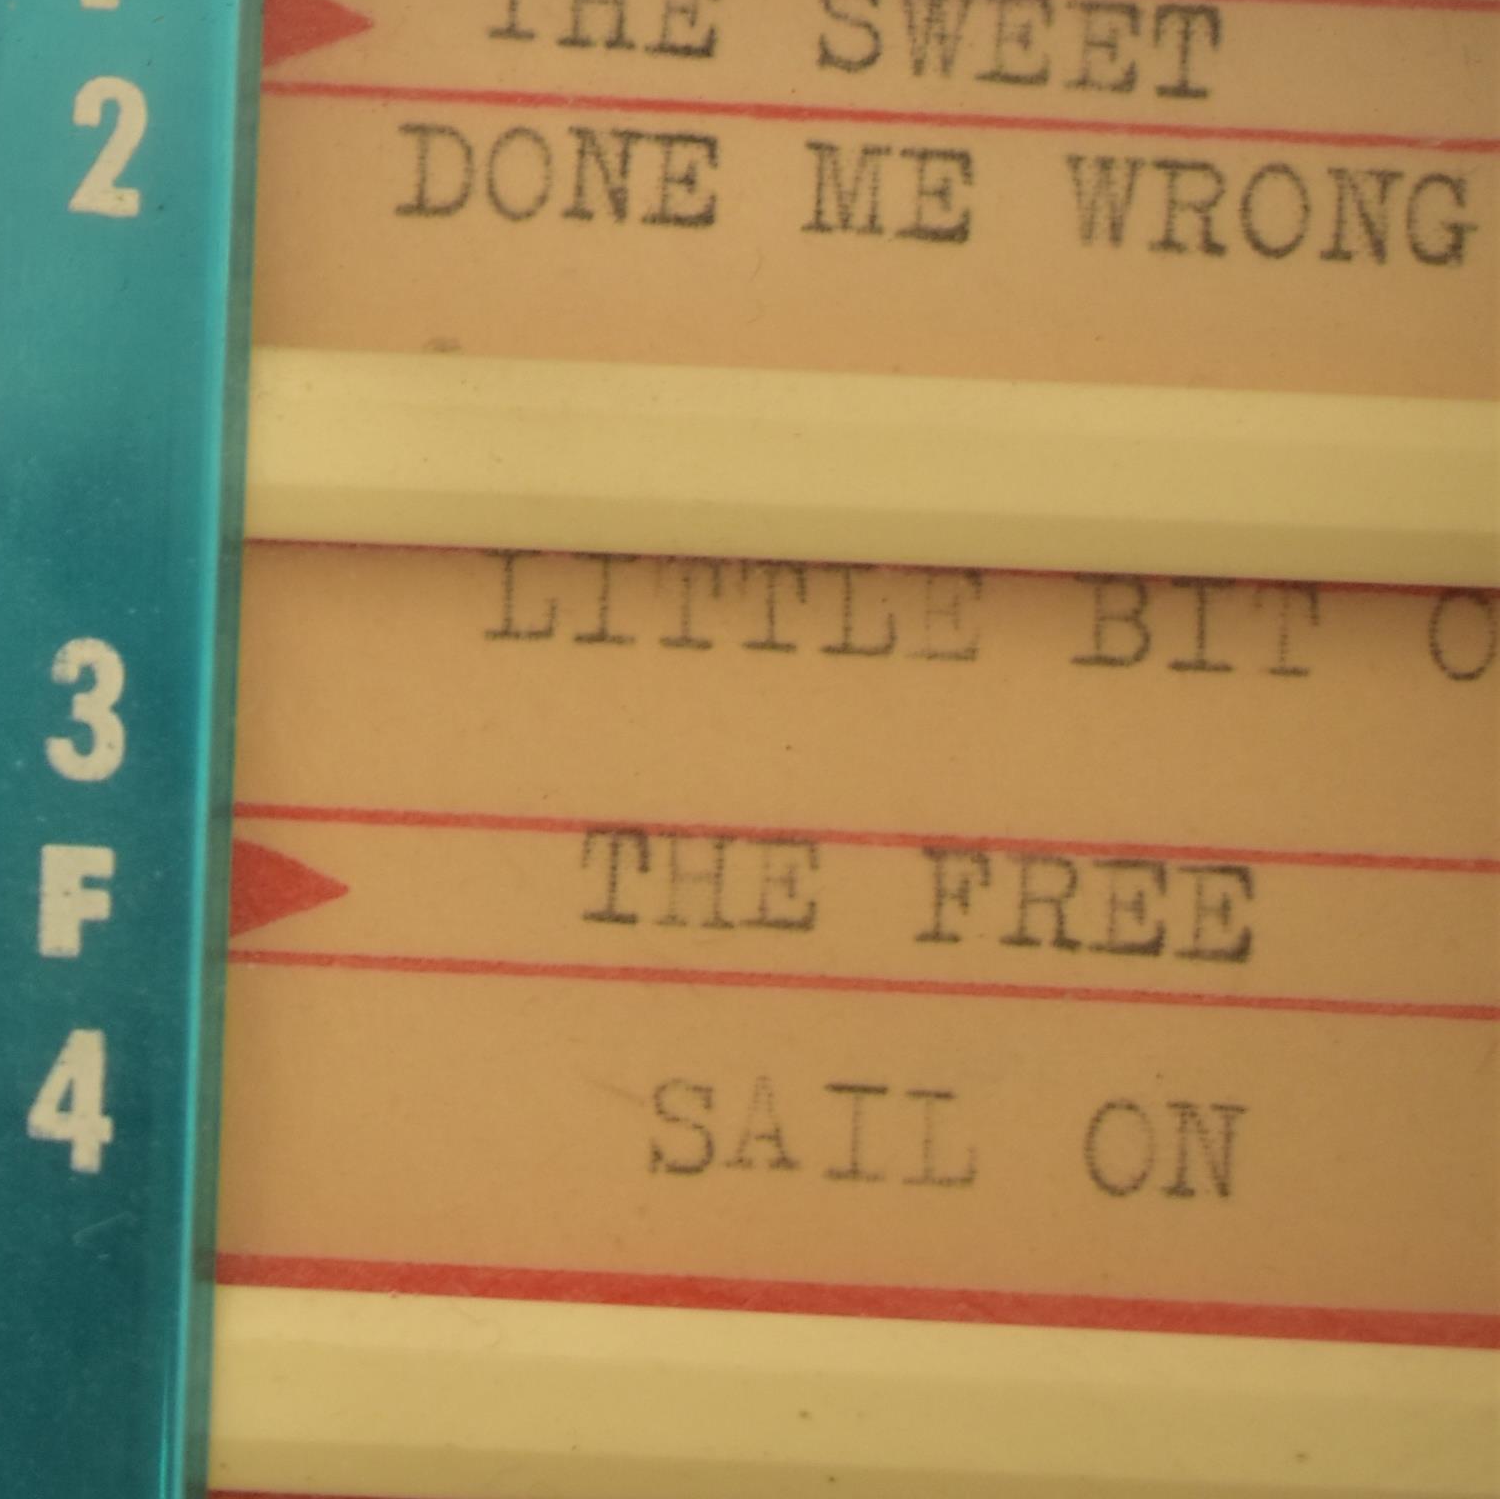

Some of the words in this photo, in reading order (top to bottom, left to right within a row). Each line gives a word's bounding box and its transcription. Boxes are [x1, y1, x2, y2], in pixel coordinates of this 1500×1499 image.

[67, 75, 149, 218] 2
[394, 121, 719, 229] DONE
[800, 139, 975, 245] ME
[1064, 152, 1481, 267] WRONG
[483, 546, 984, 662] LITTLE
[1069, 571, 1321, 678] BIT
[44, 635, 127, 783] 3
[37, 843, 116, 958] F
[580, 827, 820, 933] THE
[913, 845, 1255, 964] FREE
[26, 1028, 114, 1175] 4
[649, 1074, 979, 1189] SAIL
[1083, 1097, 1250, 1199] ON
